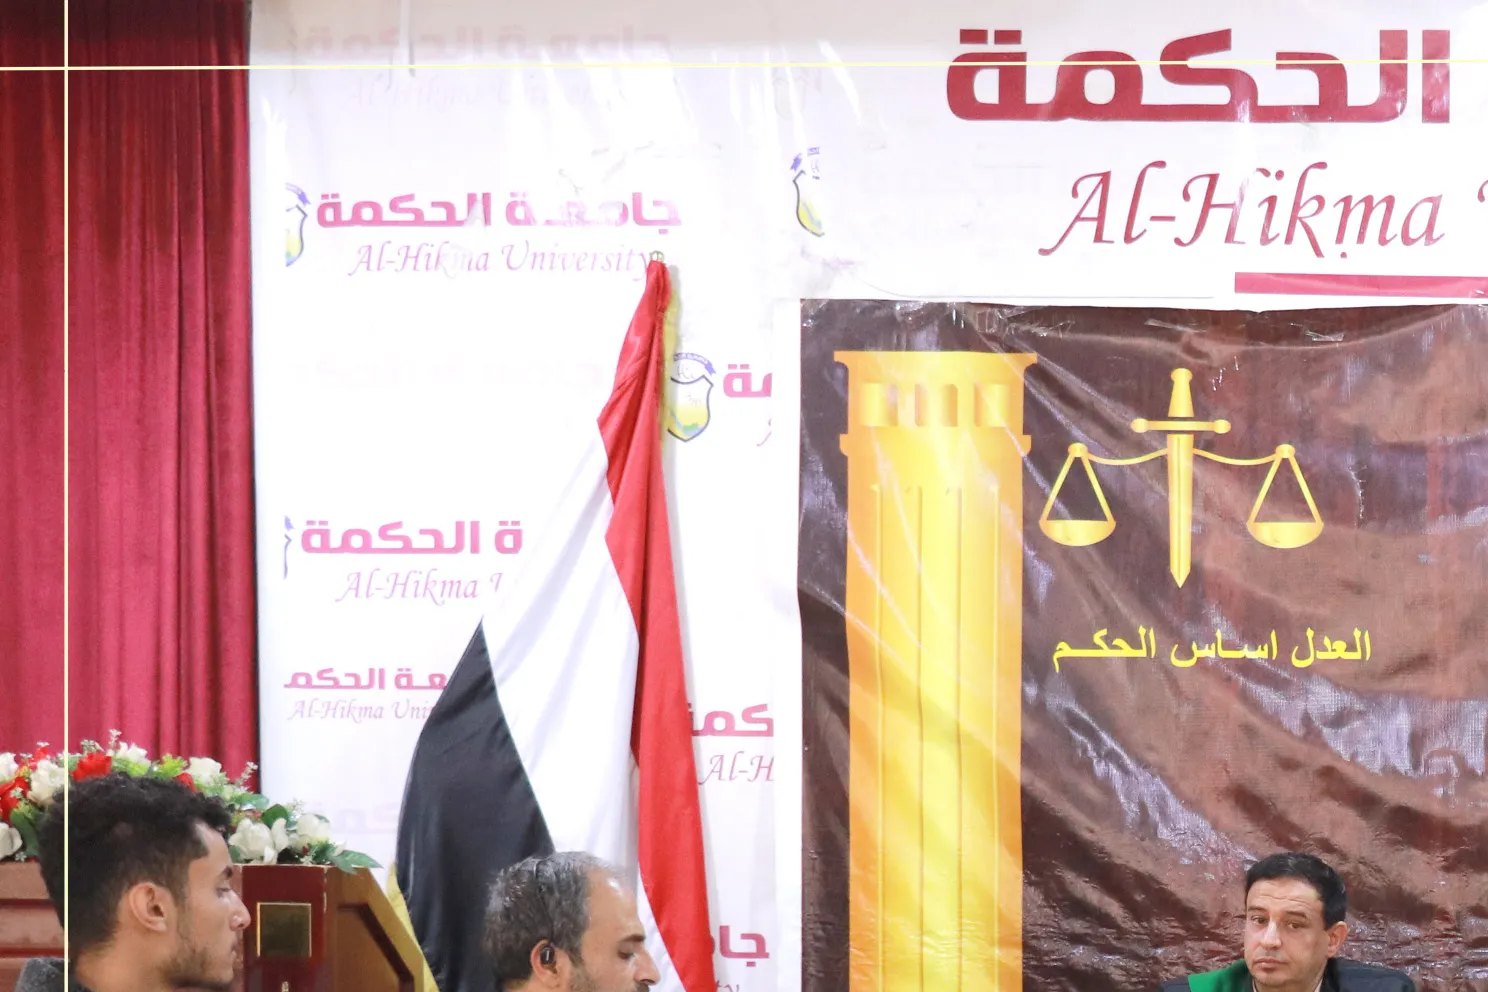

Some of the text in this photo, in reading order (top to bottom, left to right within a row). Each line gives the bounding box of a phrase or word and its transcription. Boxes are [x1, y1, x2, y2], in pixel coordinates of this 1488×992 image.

[946, 28, 1450, 124] الحكمة
[316, 192, 492, 228] الحكمة
[1037, 160, 1445, 260] Al-Hikma
[500, 240, 650, 282] University
[301, 520, 481, 555] الحكمة
[335, 568, 479, 607] Al-Hikma
[1052, 624, 1372, 673] العدل اساس الحكم
[287, 698, 385, 724] Al-Hikma
